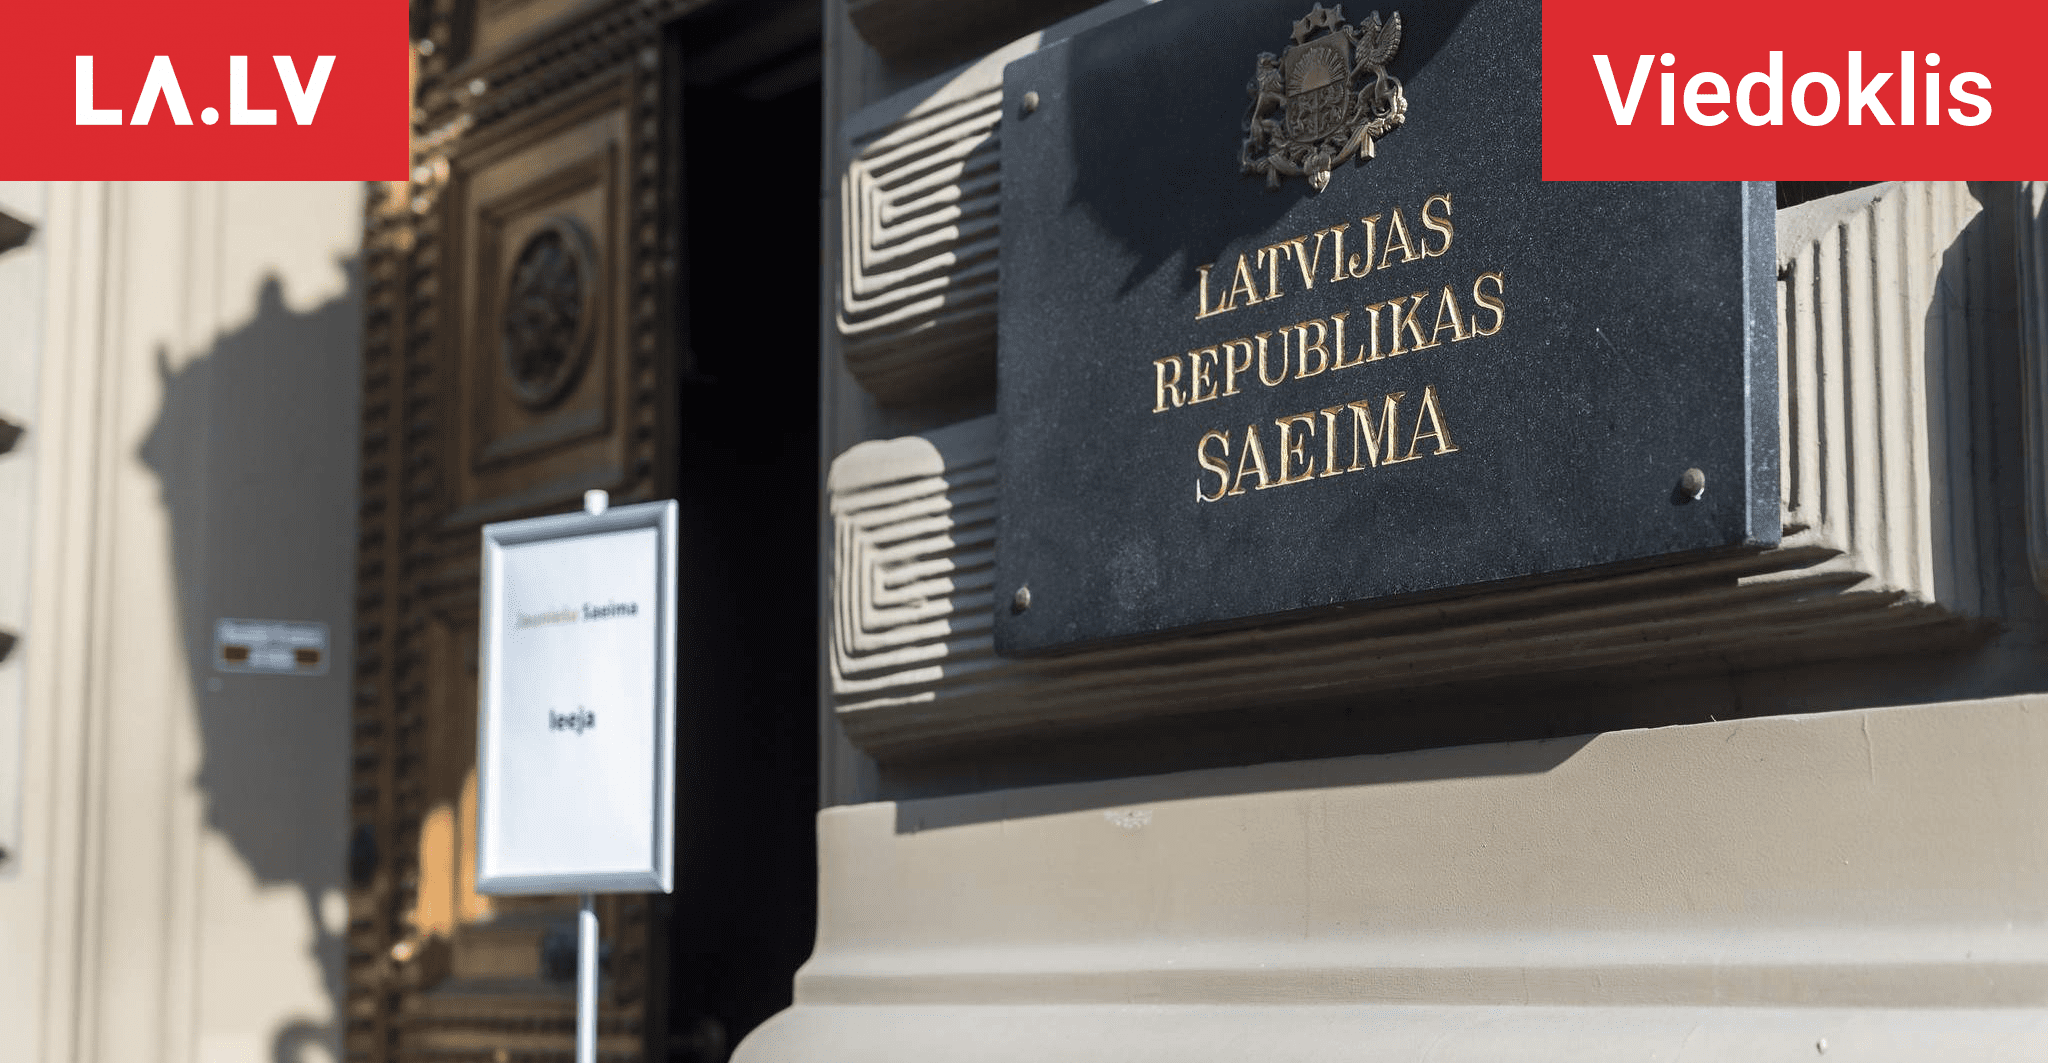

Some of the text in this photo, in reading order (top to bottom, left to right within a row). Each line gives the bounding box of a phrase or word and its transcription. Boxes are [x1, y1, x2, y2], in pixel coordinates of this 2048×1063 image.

[1196, 193, 1454, 320] LATVIJAS
[1152, 272, 1506, 413] REPUBLIKAS
[1196, 385, 1459, 502] SAEIMA
